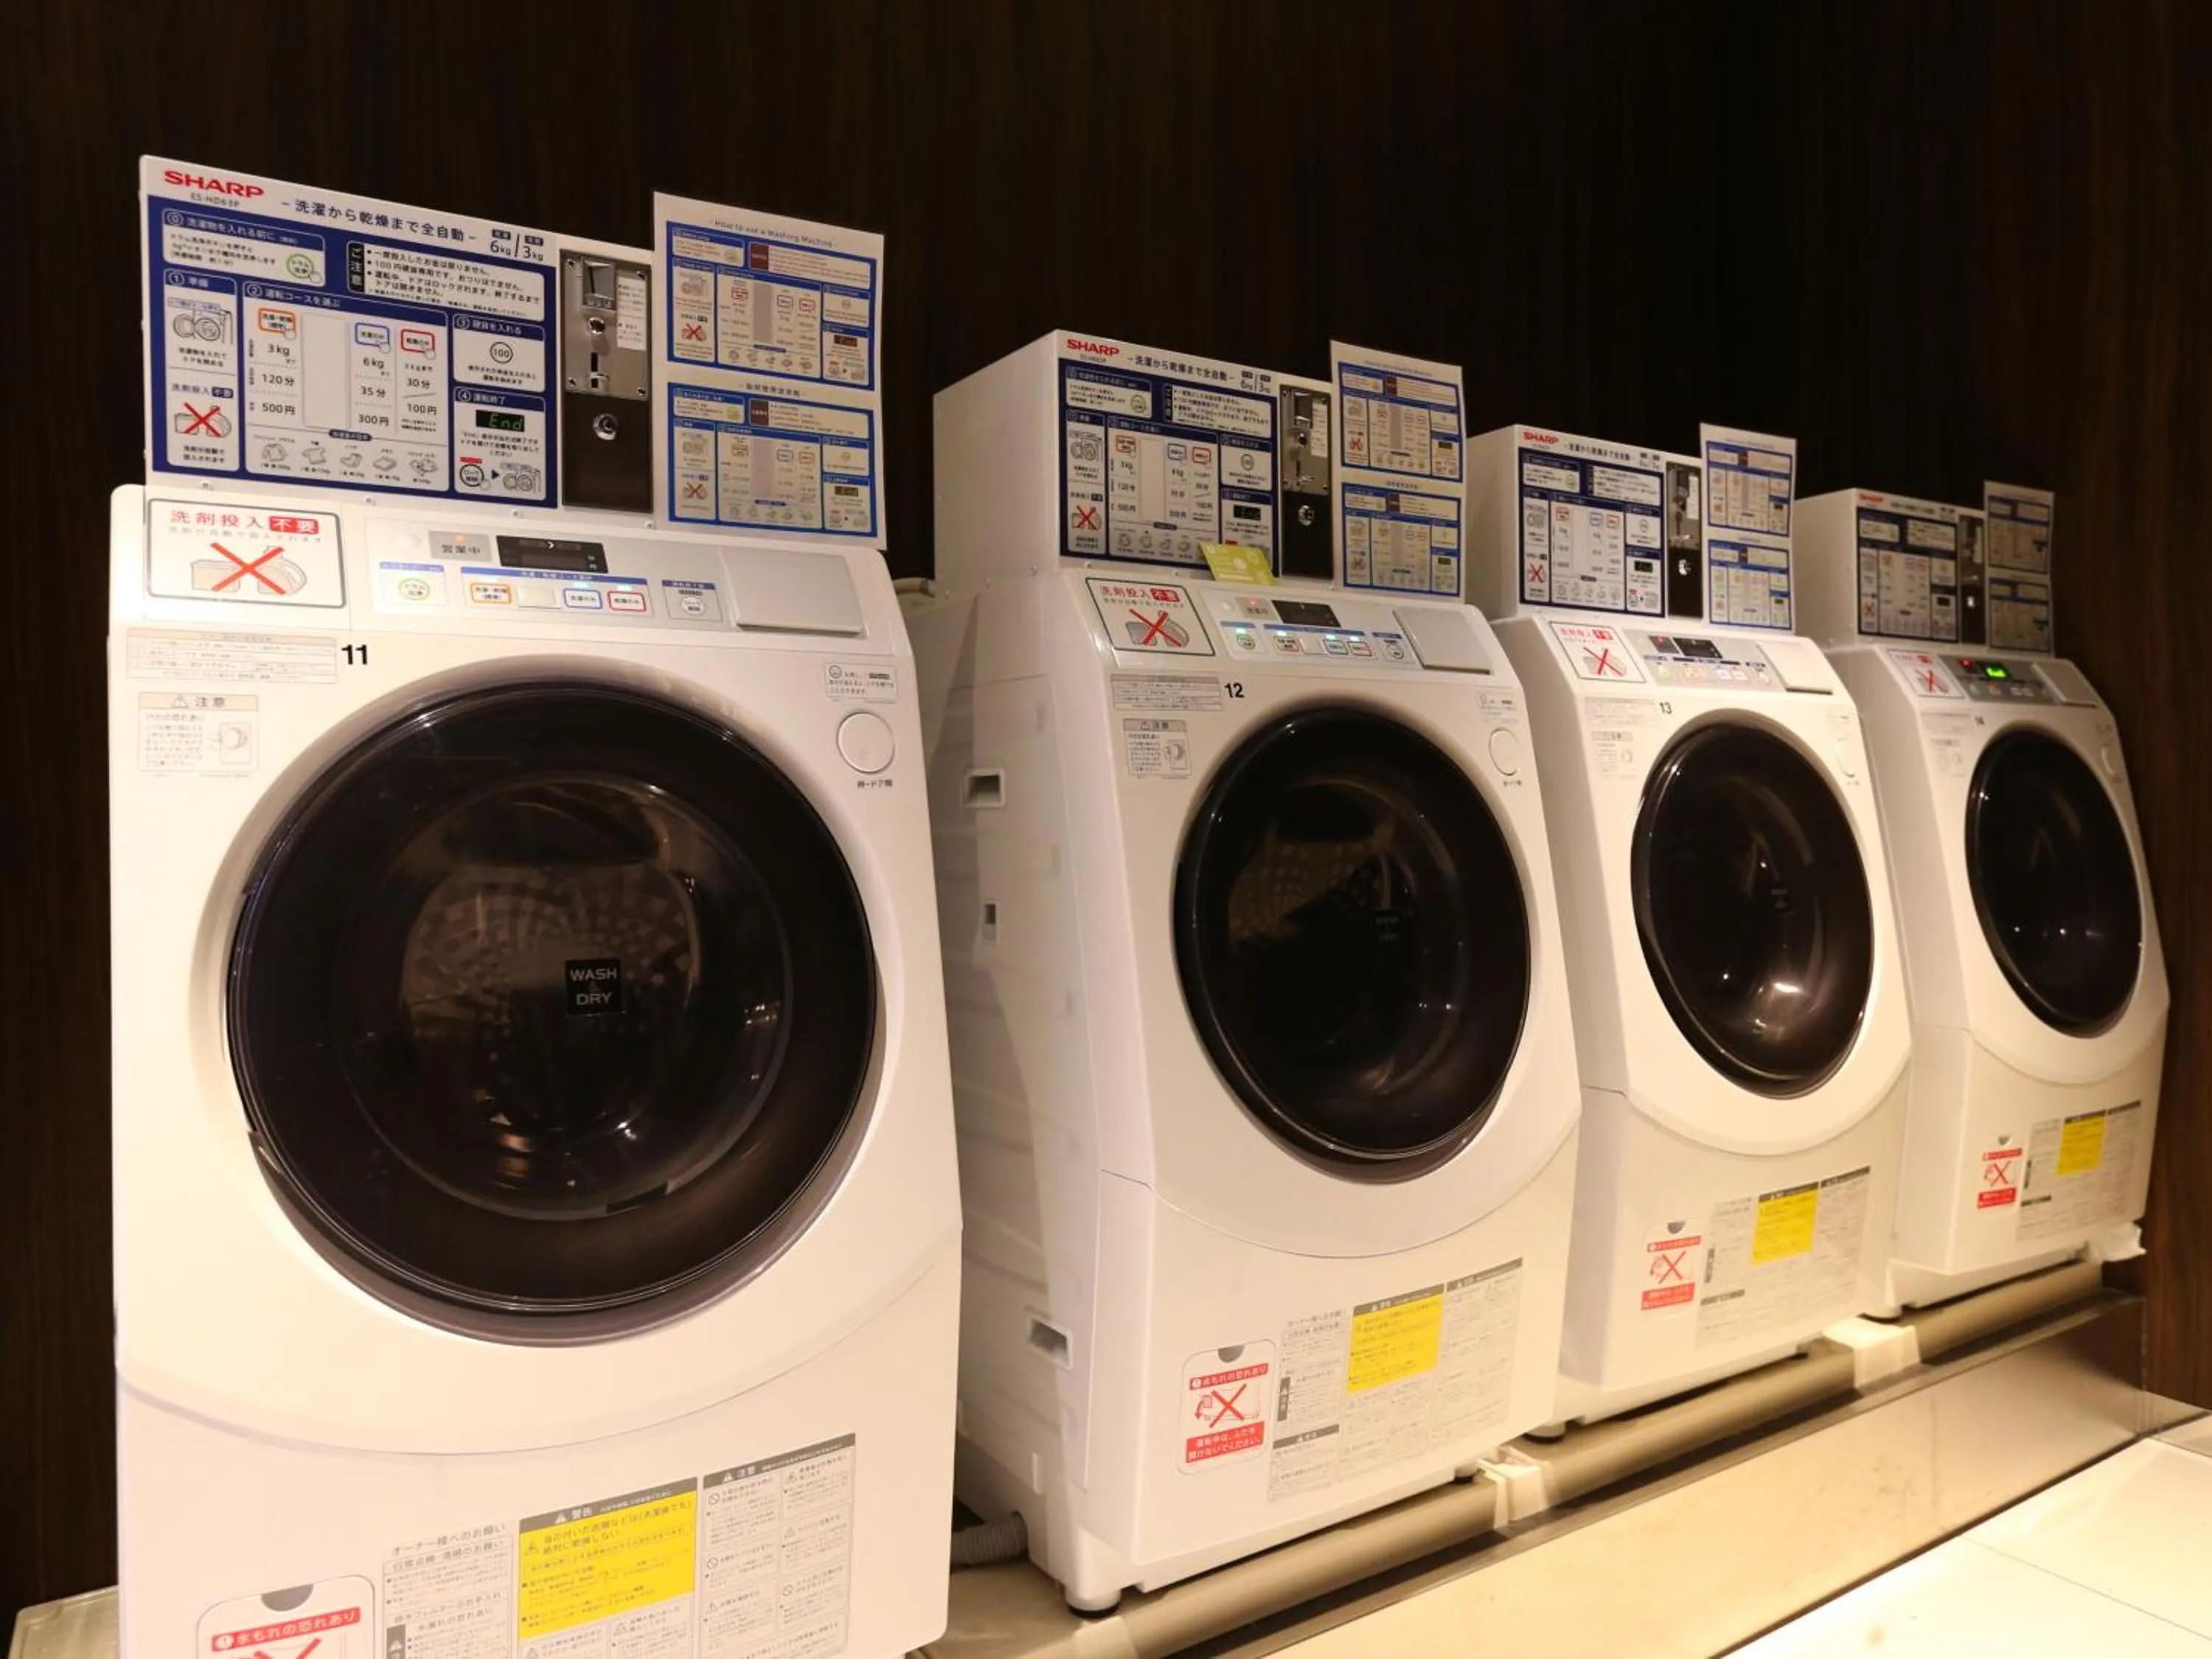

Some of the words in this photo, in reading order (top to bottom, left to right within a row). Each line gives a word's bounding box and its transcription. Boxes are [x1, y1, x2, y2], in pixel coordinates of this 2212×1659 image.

[164, 170, 265, 198] SHARP
[493, 347, 510, 359] 100
[1066, 338, 1120, 357] SHARP
[1523, 431, 1559, 444] SHARP
[170, 509, 265, 529] 洗剤投入
[270, 517, 318, 535] 不要
[341, 644, 368, 665] 11
[1224, 682, 1245, 699] 12
[1659, 701, 1673, 715] 13
[569, 967, 618, 982] WASH
[576, 991, 613, 1006] DRY
[235, 1610, 357, 1644] 水もれの恐れあり
